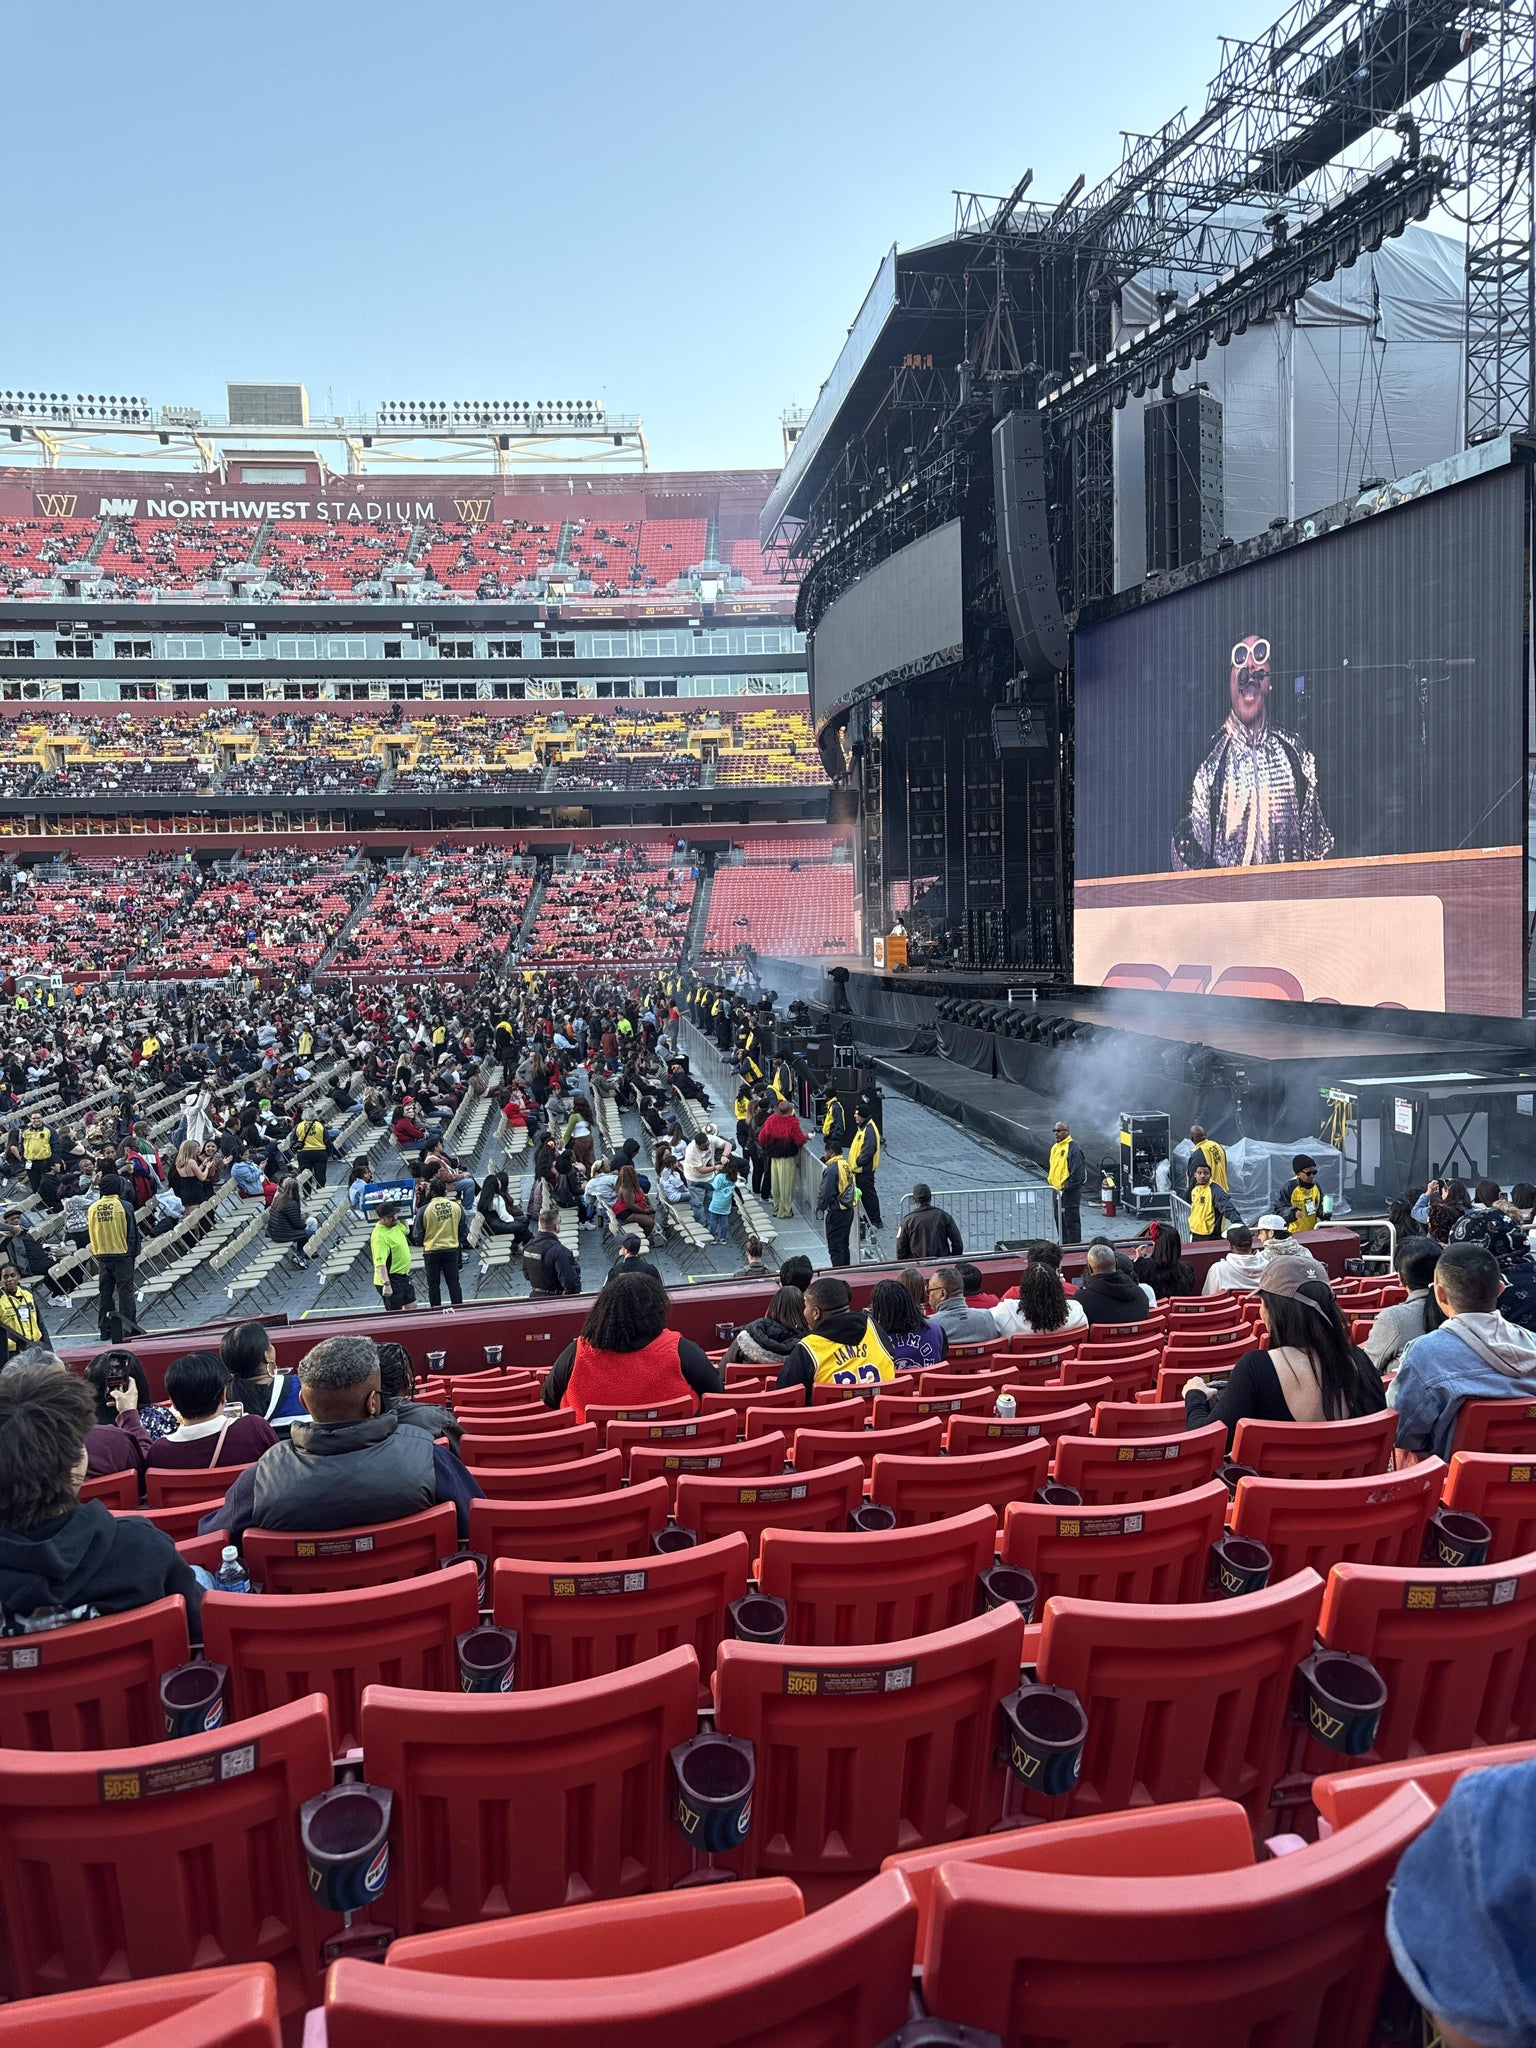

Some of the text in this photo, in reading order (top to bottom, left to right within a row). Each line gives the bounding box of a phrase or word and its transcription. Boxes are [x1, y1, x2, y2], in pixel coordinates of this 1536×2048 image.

[146, 500, 310, 519] NORTHWEST
[317, 502, 434, 520] STADIUM
[645, 607, 655, 615] 20
[52, 977, 61, 985] A1
[96, 1203, 114, 1211] CSC
[434, 1201, 452, 1210] CSC
[833, 1343, 867, 1366] JAMES
[1407, 1592, 1435, 1605] 5050
[788, 1678, 817, 1691] 5050
[104, 1780, 140, 1796] 5050
